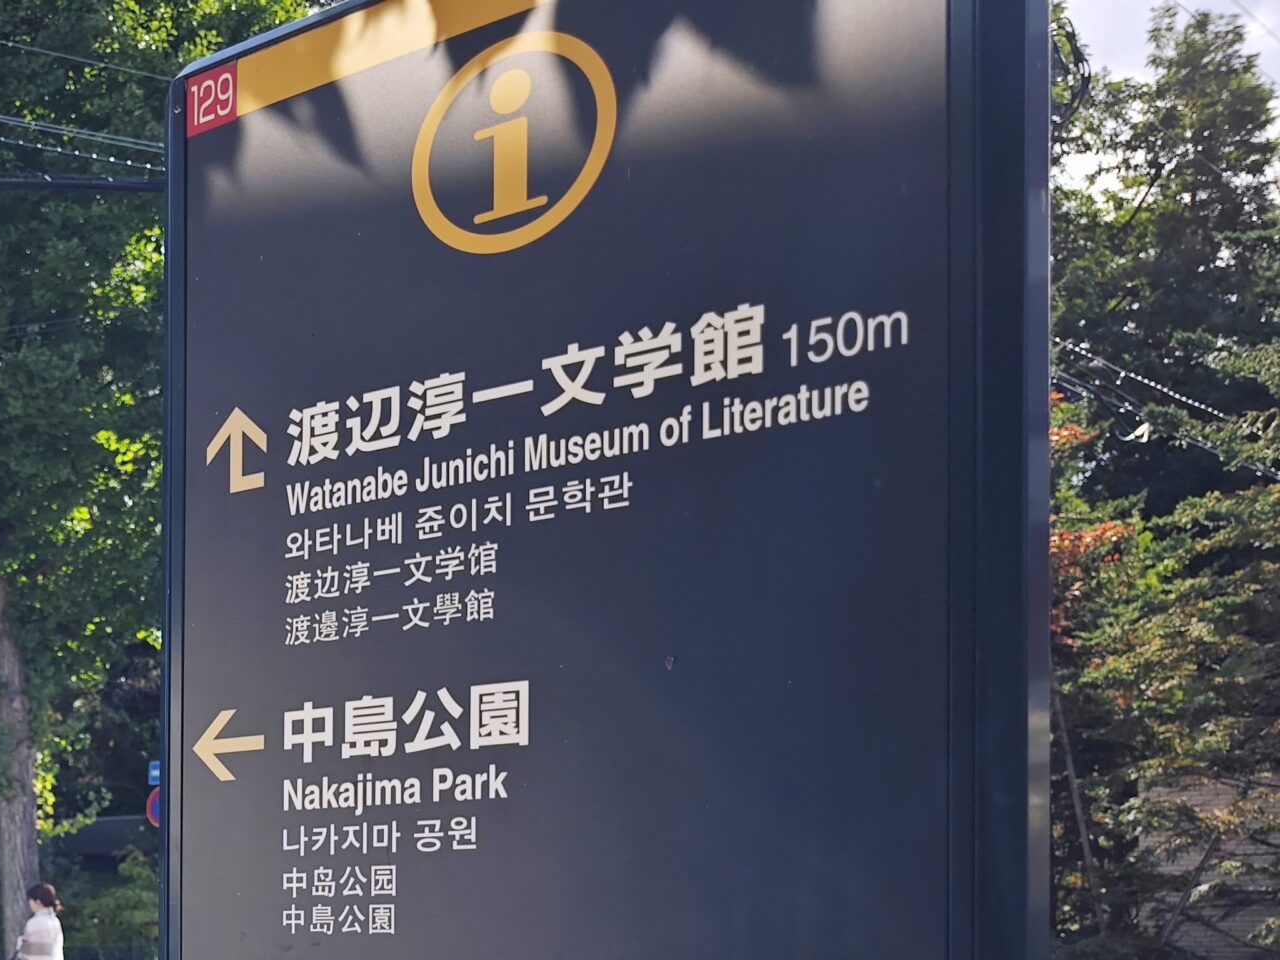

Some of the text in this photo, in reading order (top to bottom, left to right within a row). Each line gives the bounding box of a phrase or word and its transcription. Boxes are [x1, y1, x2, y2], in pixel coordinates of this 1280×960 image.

[190, 72, 233, 126] 129
[286, 303, 908, 467] 渡辺淳一文学館 150m
[285, 380, 870, 516] Watanabe Junichi Museum of Literature
[284, 471, 633, 560] 와타나베 쥰이치 문학관
[284, 540, 499, 604] 渡边淳一文学馆
[283, 680, 529, 764] 中島公園
[283, 764, 508, 816] Nakajima Park
[282, 816, 477, 857] 나카지마 공원
[282, 864, 397, 899] 中岛公园
[282, 903, 395, 935] 中島公園
